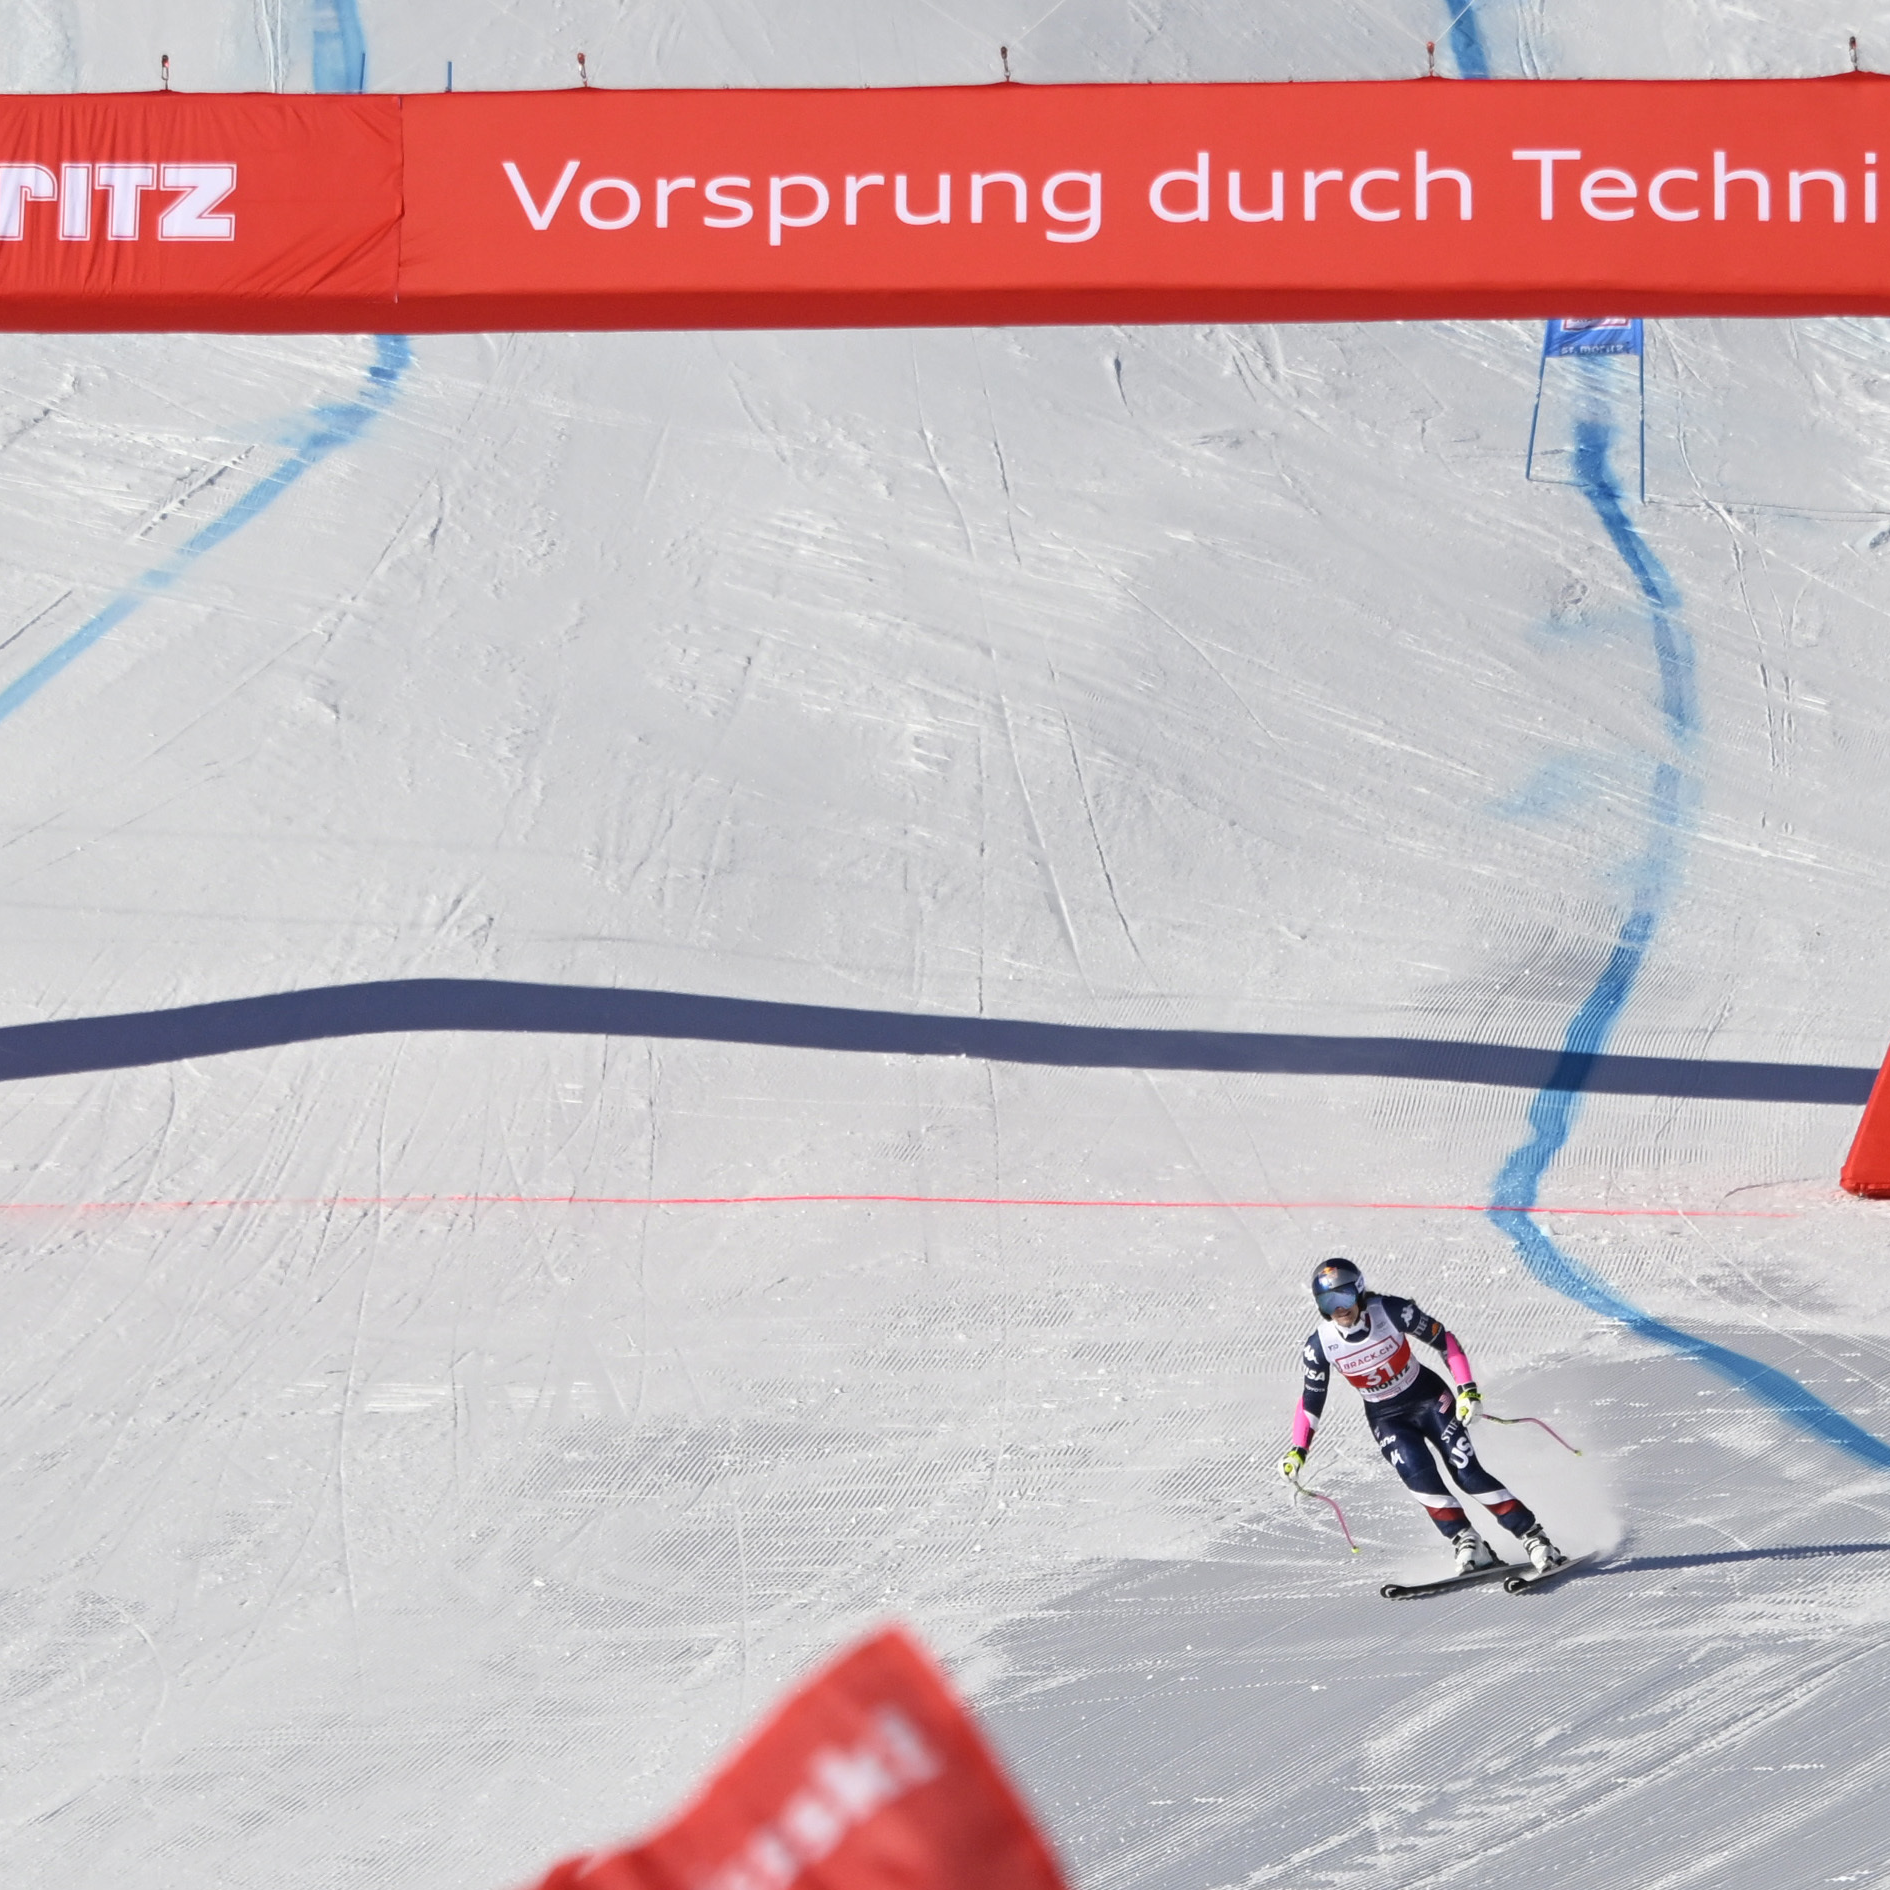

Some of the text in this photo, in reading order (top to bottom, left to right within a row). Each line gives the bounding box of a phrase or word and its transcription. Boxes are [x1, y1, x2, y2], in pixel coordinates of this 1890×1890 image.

[503, 161, 1102, 246] Vorsprung
[1149, 151, 1472, 223] durch
[1344, 1344, 1394, 1370] BRACK.CH
[1362, 1363, 1396, 1387] 31
